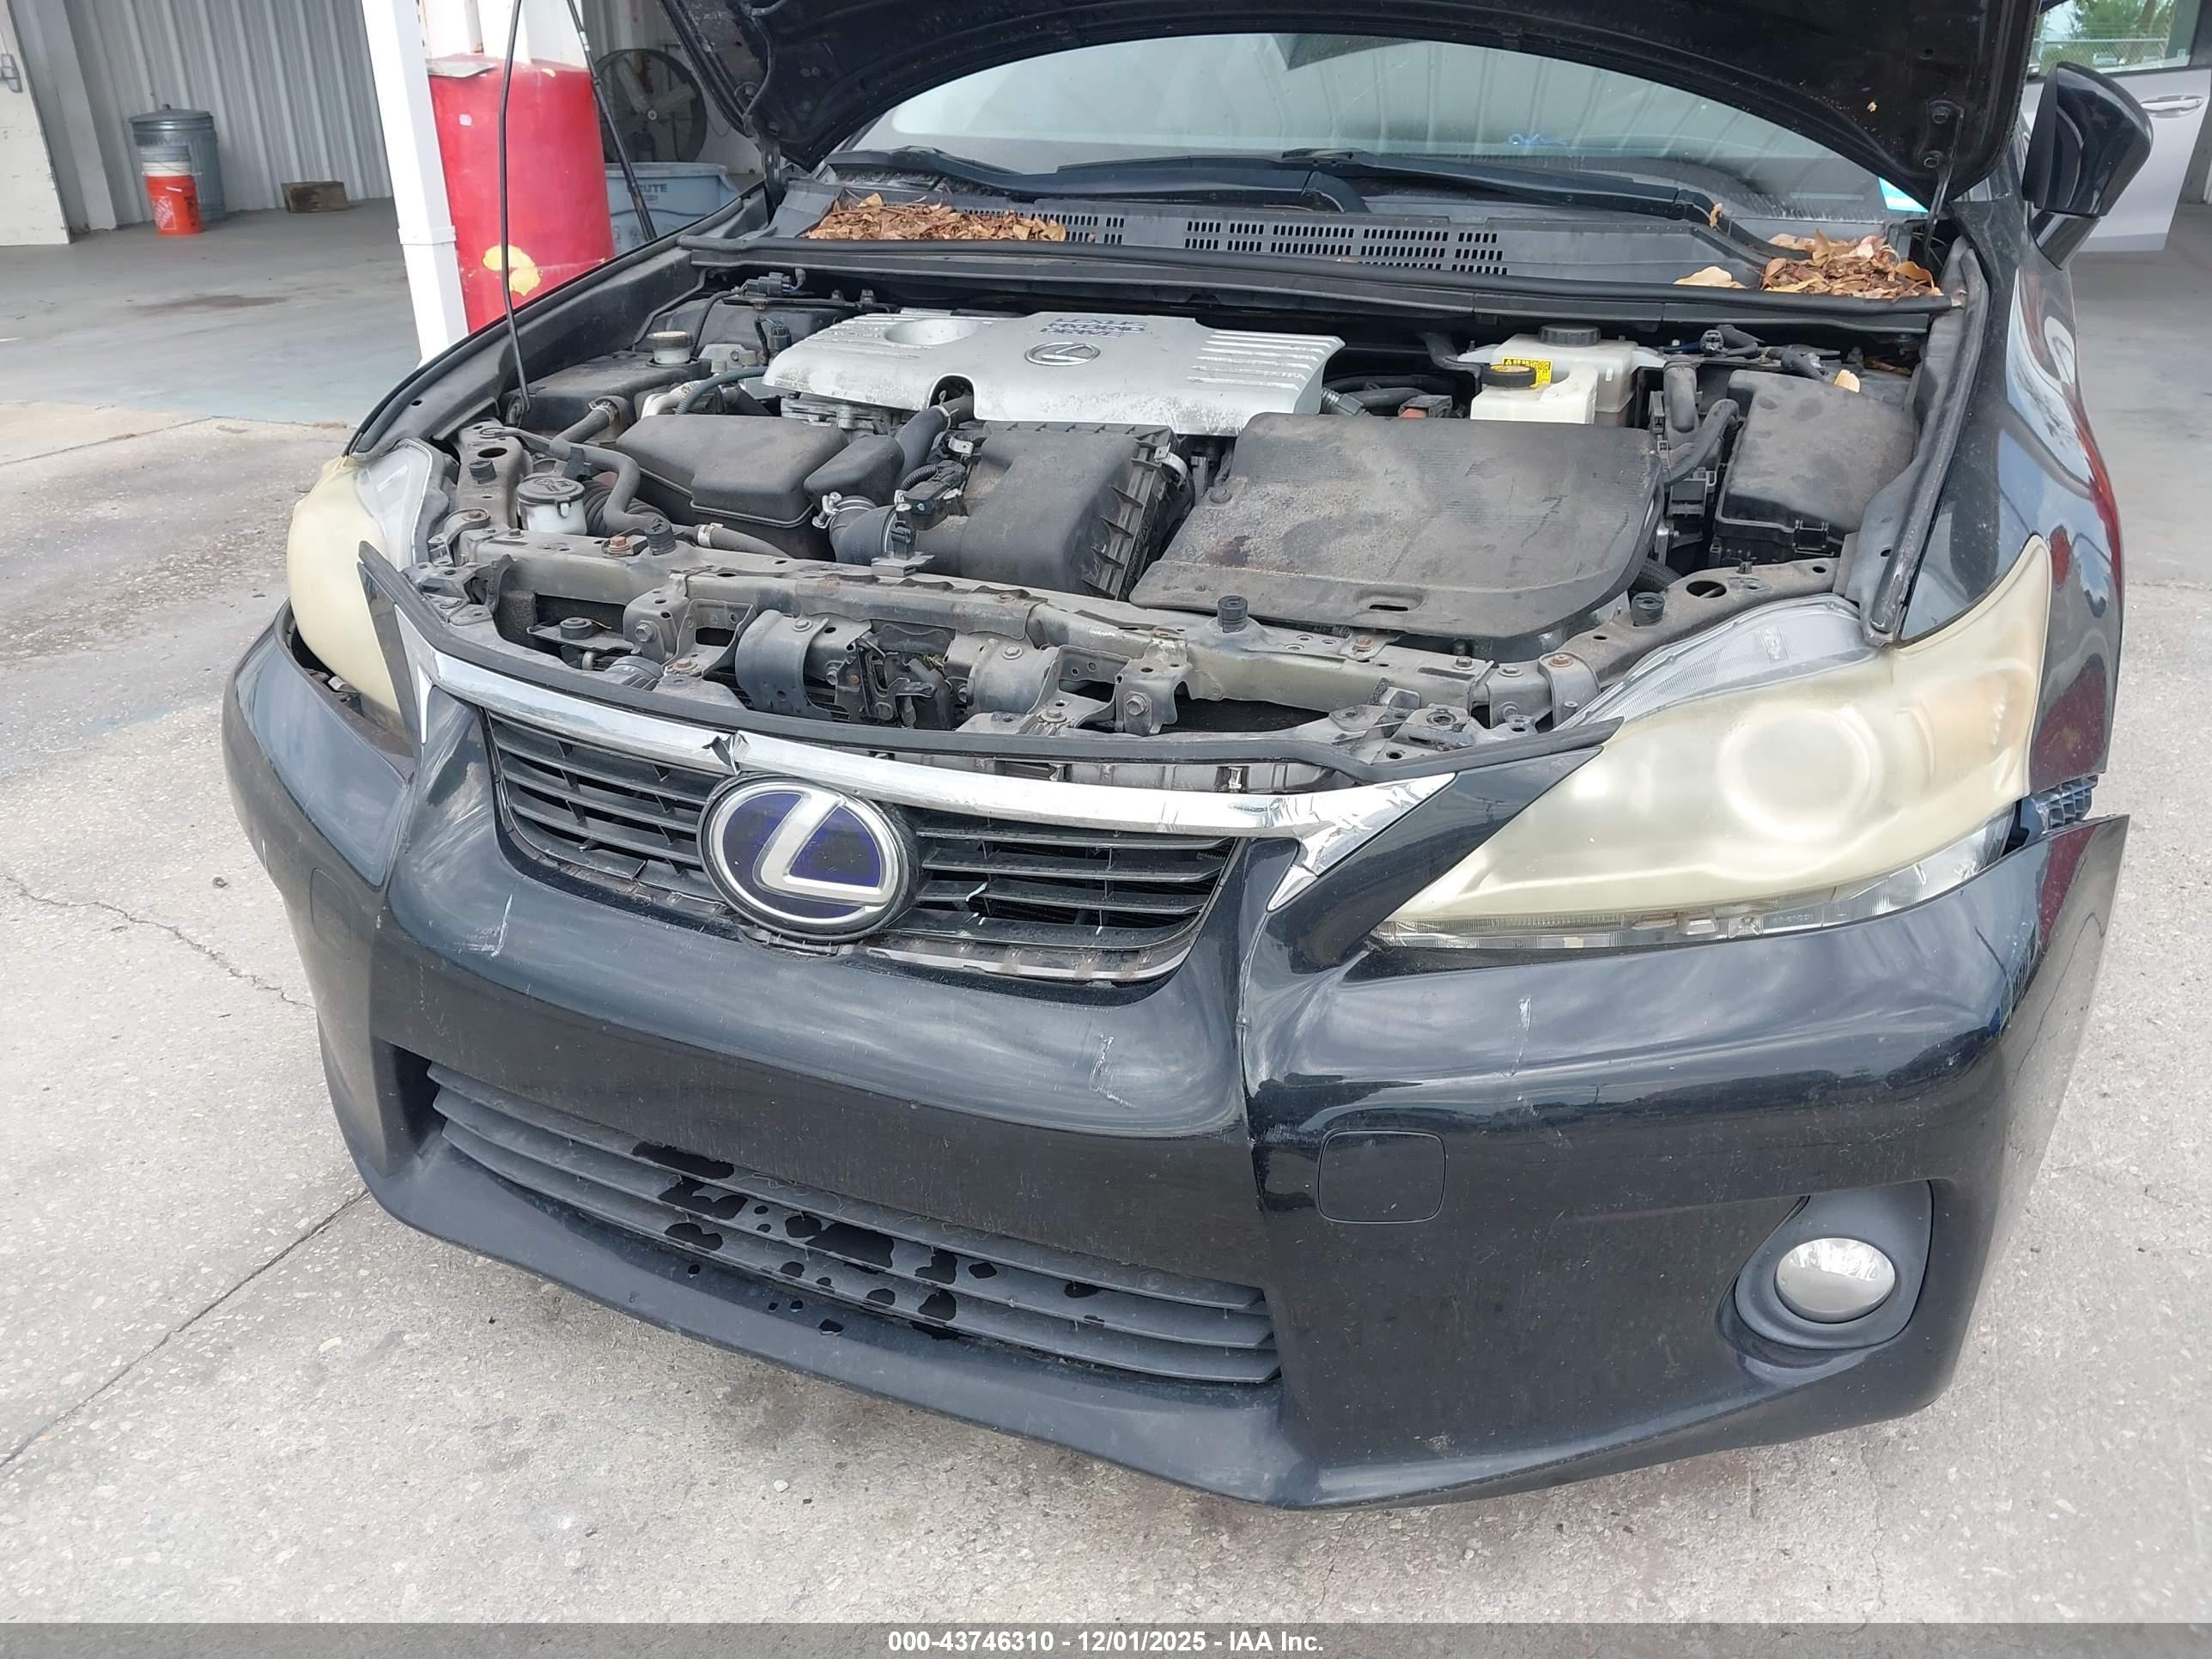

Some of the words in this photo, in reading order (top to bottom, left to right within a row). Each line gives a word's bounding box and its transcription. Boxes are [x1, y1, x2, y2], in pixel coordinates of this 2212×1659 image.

[1045, 323, 1146, 333] HYBRID
[1055, 318, 1148, 328] LEXUS
[1038, 328, 1122, 337] DRIVE
